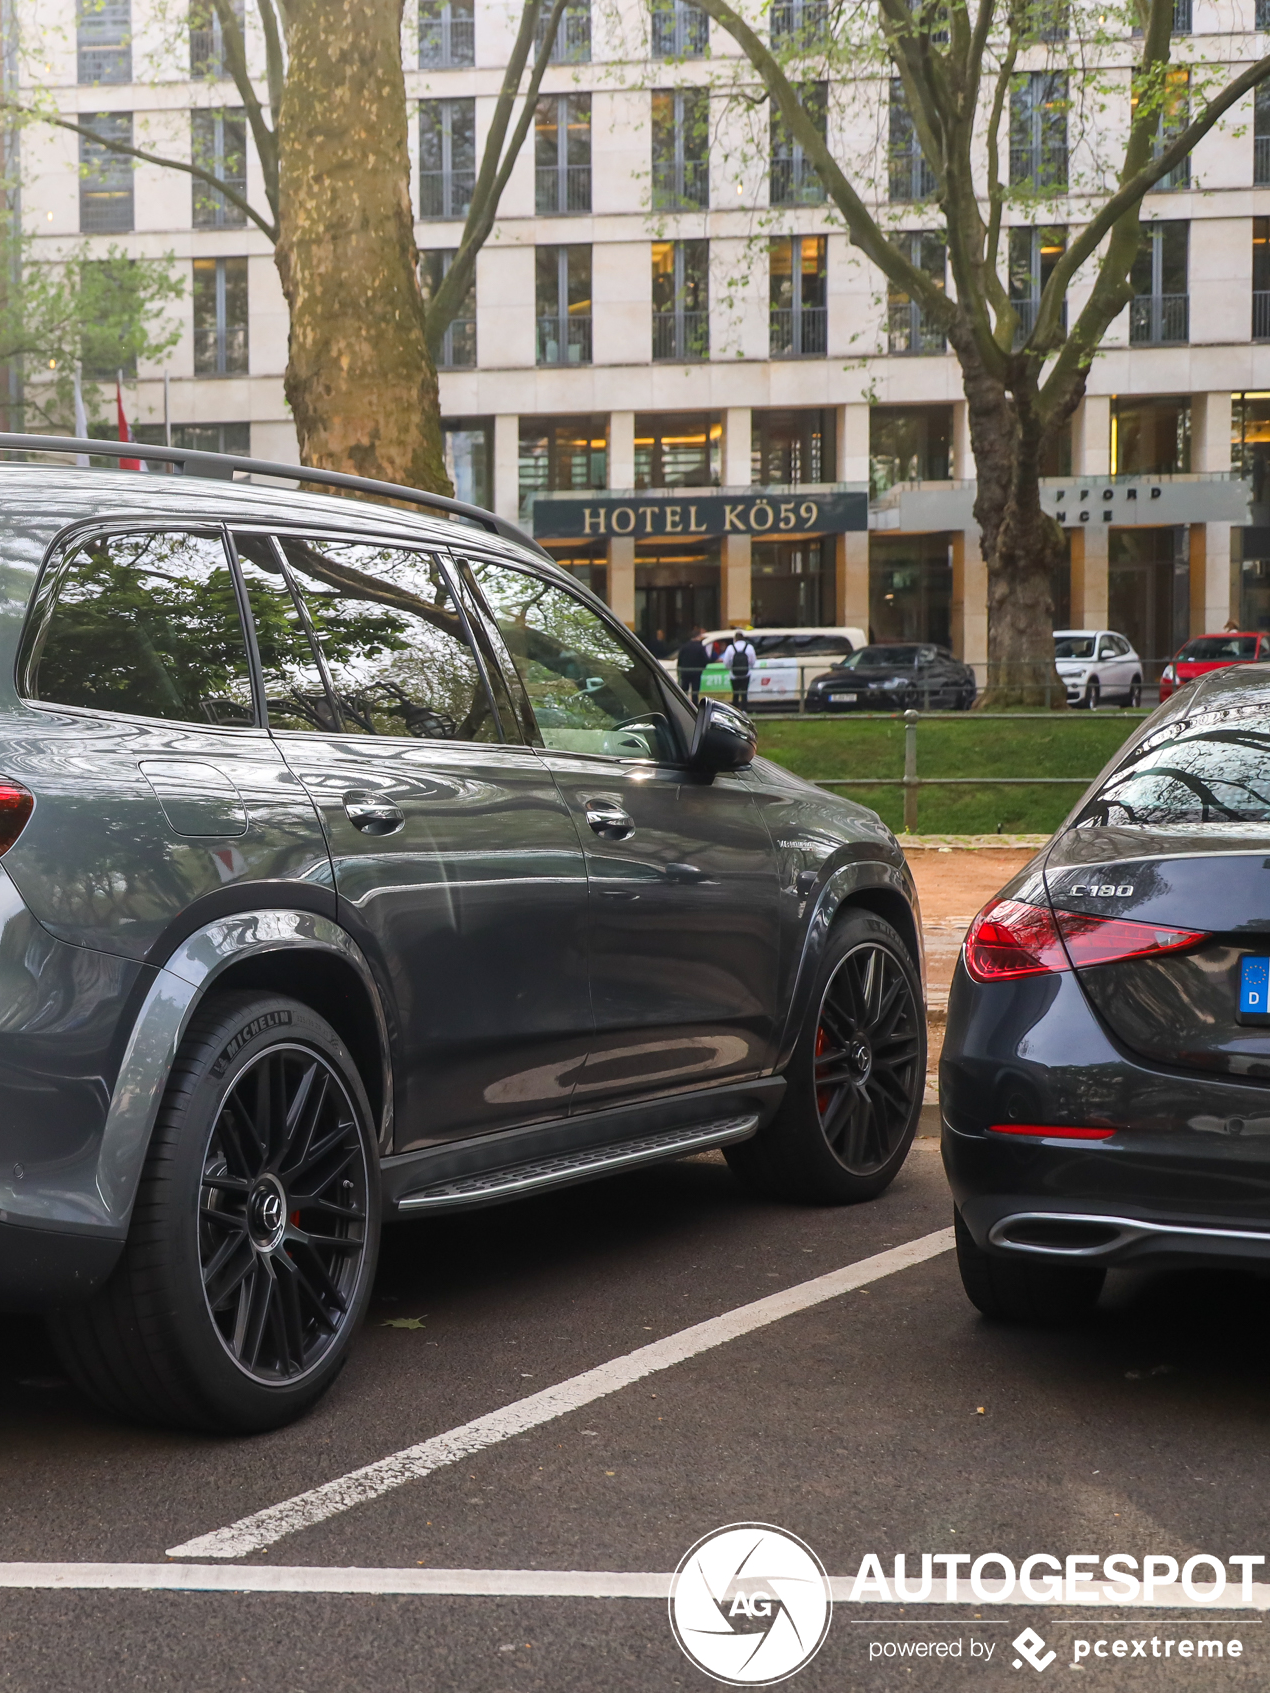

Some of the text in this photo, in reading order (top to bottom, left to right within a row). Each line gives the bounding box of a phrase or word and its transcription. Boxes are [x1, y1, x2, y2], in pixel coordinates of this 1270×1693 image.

[1056, 487, 1162, 502] FFORD
[582, 499, 818, 534] HOTEL KÖ59
[1056, 510, 1113, 523] NCE
[1088, 884, 1134, 898] 180
[1248, 991, 1260, 1005] D
[227, 1011, 290, 1060] MICHELIN
